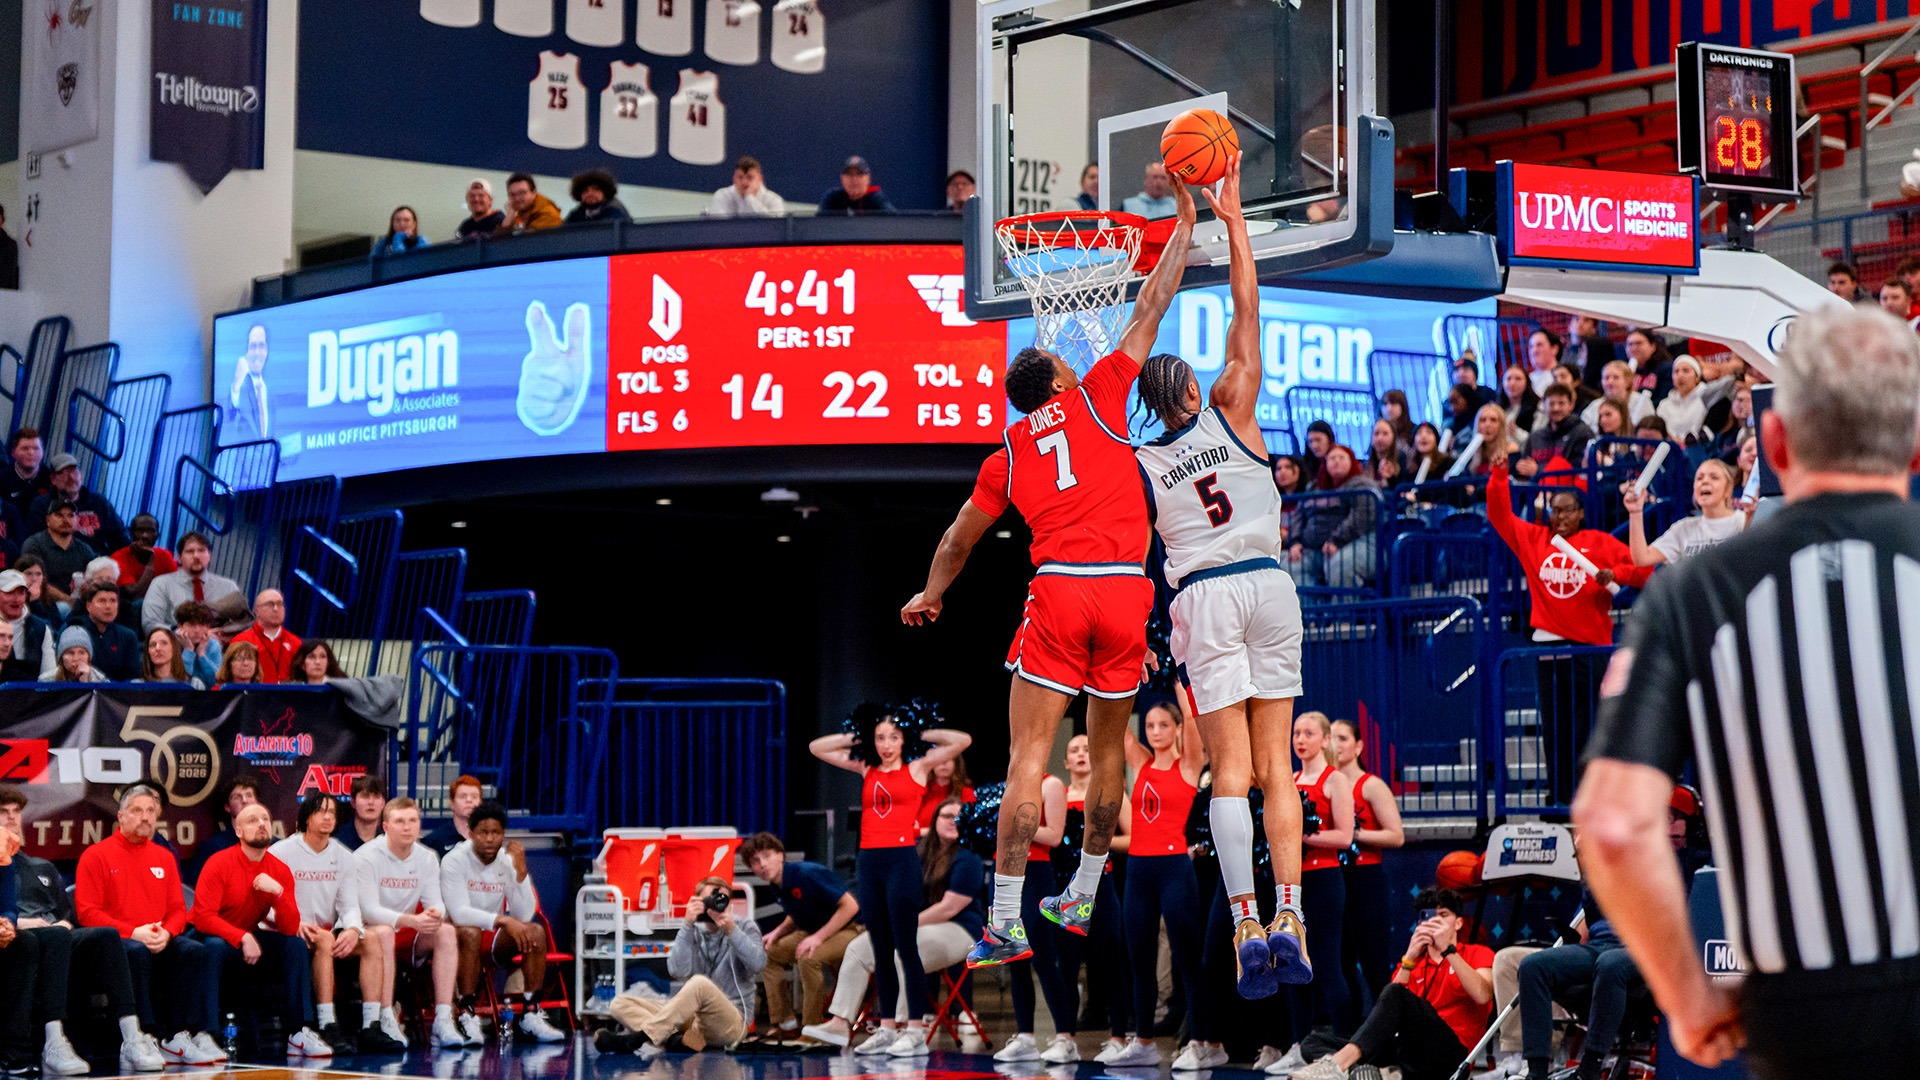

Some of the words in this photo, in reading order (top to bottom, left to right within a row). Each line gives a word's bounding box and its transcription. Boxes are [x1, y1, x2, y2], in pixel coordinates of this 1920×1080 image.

[173, 3, 201, 23] FAN
[208, 7, 243, 29] ZONE
[1709, 52, 1774, 70] DAKTRONICS
[155, 72, 241, 113] Helltown
[547, 85, 569, 111] 25
[1715, 116, 1762, 169] 28
[1018, 158, 1050, 195] 212
[1518, 191, 1614, 234] UPMC
[1624, 199, 1676, 220] SPORTS
[1624, 218, 1688, 238] MEDICINE
[745, 268, 856, 317] 4:41
[758, 326, 809, 349] PER:
[813, 325, 855, 348] 1ST
[1180, 292, 1373, 398] Dgan
[641, 344, 689, 365] POSS
[307, 329, 459, 417] Dugan
[617, 371, 662, 395] TOL
[673, 369, 690, 393] 3
[913, 363, 963, 388] TOL
[976, 363, 993, 388] 4
[393, 397, 401, 414] &
[402, 392, 459, 413] Associates
[721, 372, 784, 421] 14
[822, 370, 890, 419] 22
[617, 410, 659, 434] FLS
[672, 408, 689, 431] 6
[917, 404, 962, 427] FLS
[976, 404, 993, 427] 5
[1028, 401, 1066, 436] JONES
[307, 432, 336, 450] MAIN
[338, 424, 377, 445] OFFICE
[380, 414, 457, 440] PITTSBURGH
[1035, 428, 1079, 493] 7
[1160, 445, 1229, 490] CRAWFORD
[1192, 470, 1234, 529] 5
[119, 705, 220, 807] 50
[297, 731, 313, 757] 10
[179, 752, 208, 765] 1976
[178, 767, 207, 779] 2026
[1512, 838, 1542, 851] MARCH
[1515, 850, 1557, 863] MADNESS
[584, 911, 615, 921] GATORADE
